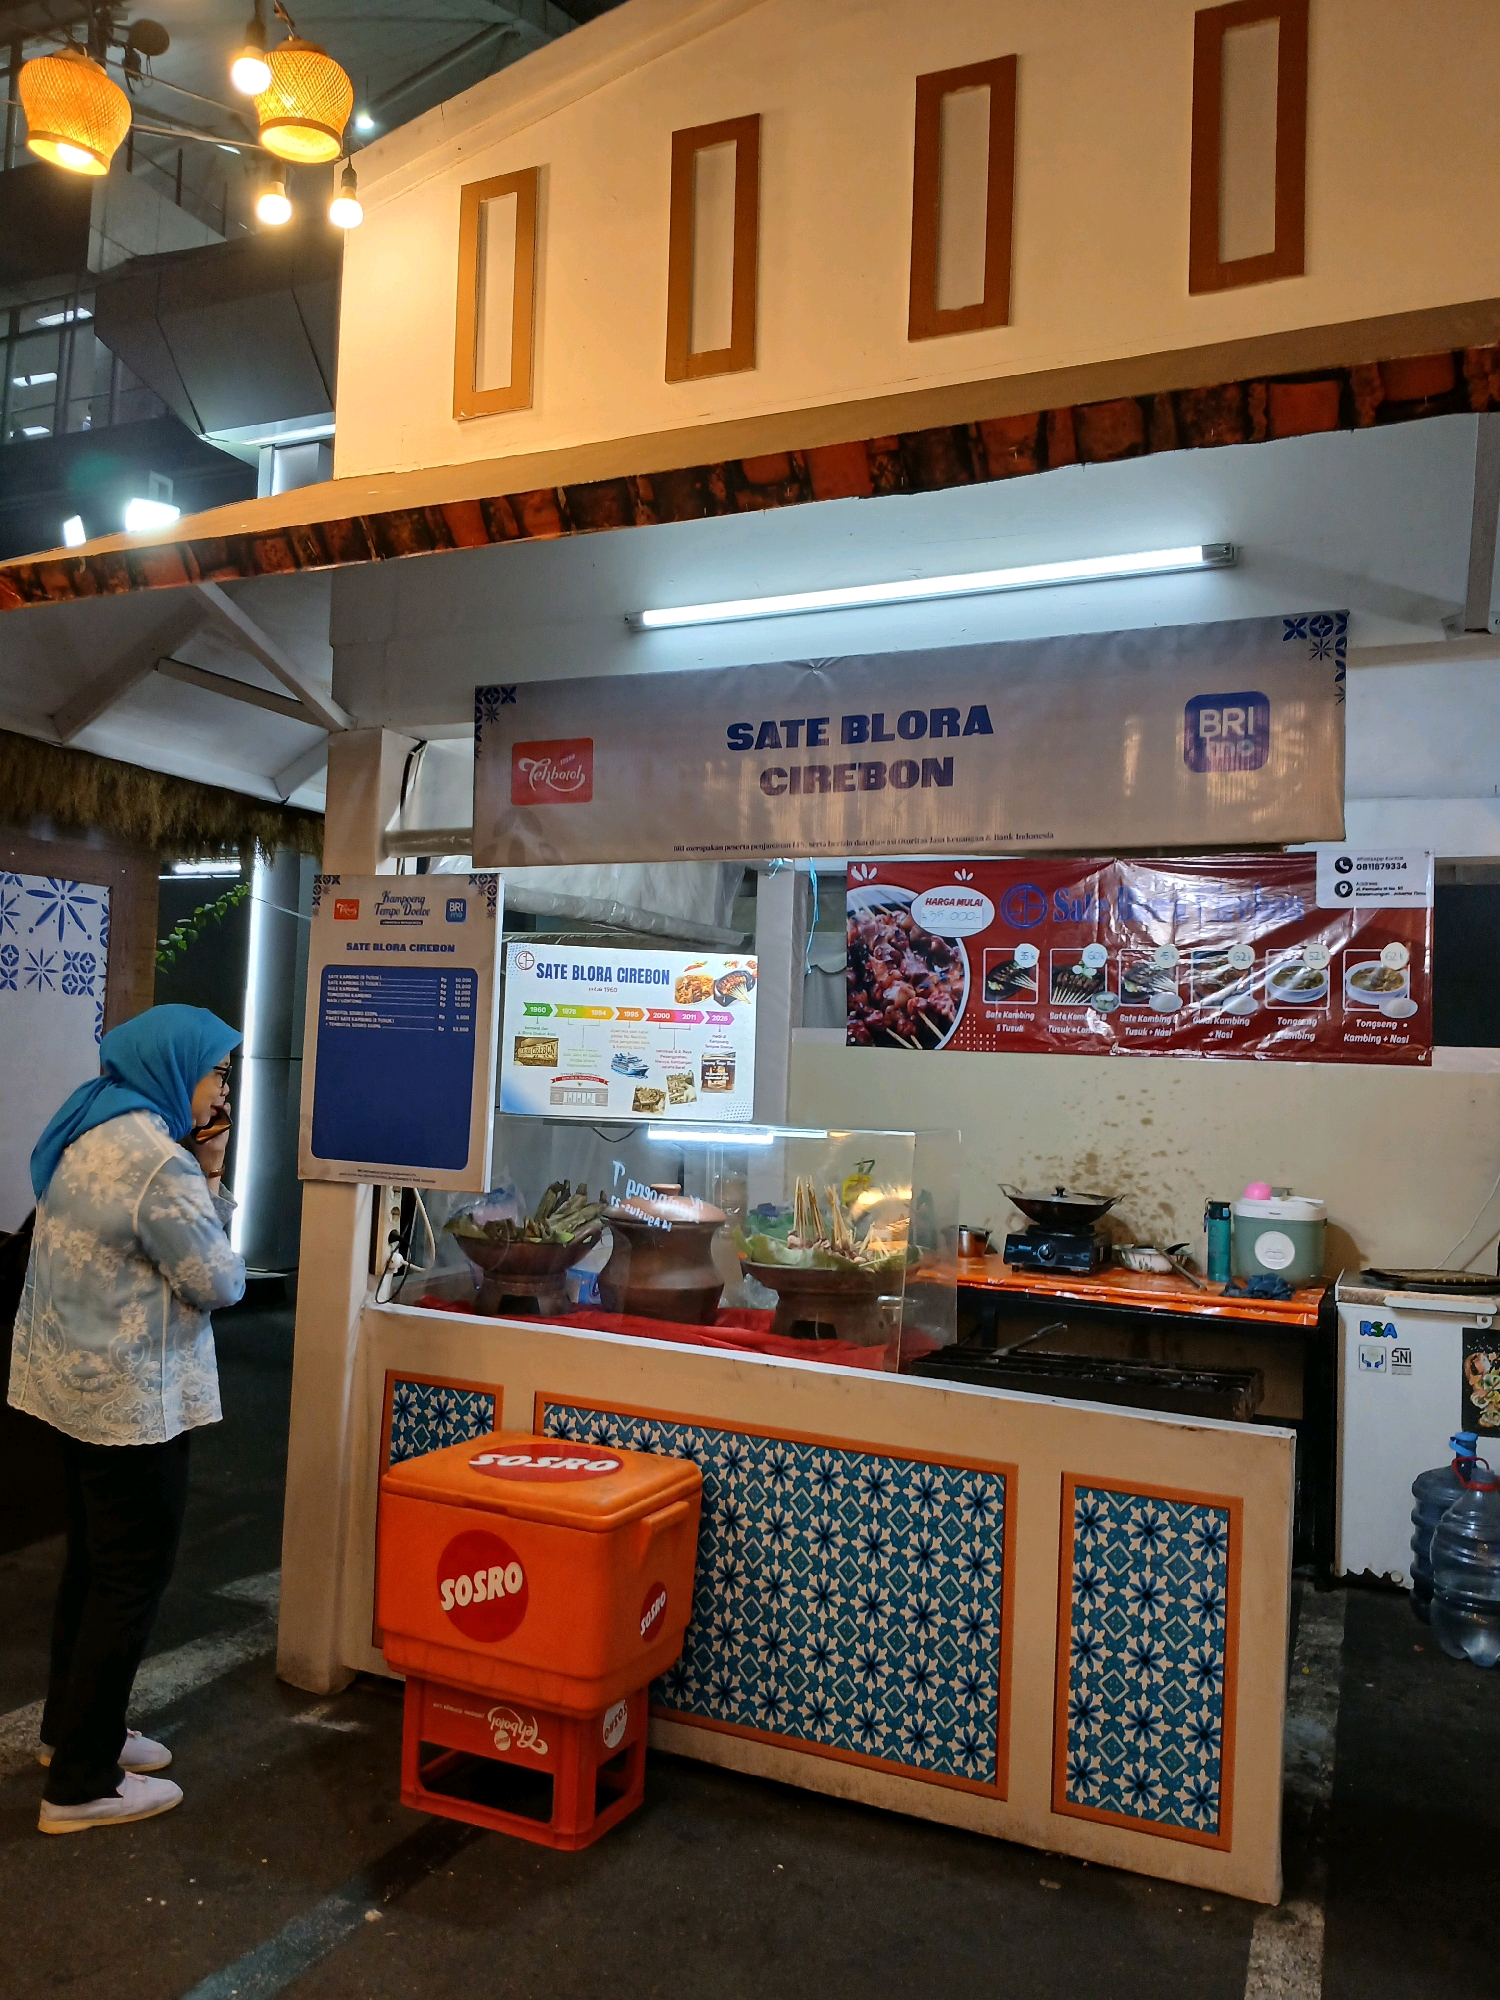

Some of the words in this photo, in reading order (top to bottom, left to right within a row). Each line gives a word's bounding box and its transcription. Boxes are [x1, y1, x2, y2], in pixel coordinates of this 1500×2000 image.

[1199, 706, 1255, 738] BRI
[727, 717, 830, 751] SATE
[840, 705, 994, 745] BLORA
[518, 757, 586, 792] Tehbotol
[759, 756, 954, 797] CIREBON
[1015, 831, 1055, 841] Indonesia
[382, 890, 426, 905] Kampoeng
[925, 897, 955, 906] HARGA
[956, 898, 983, 907] MULAI
[374, 903, 400, 918] Tempo
[449, 902, 464, 912] BRI
[346, 942, 371, 951] SATE
[372, 943, 407, 952] BLORA
[409, 944, 456, 953] CIREBON
[536, 962, 568, 980] SATE
[572, 965, 613, 983] BLORA
[617, 967, 670, 985] CIREBON
[623, 1010, 640, 1018] 1995
[653, 1012, 671, 1020] 2000
[682, 1013, 697, 1021] 2011
[985, 1011, 1003, 1020] Sate
[1004, 1011, 1035, 1021] Kambing
[1049, 1012, 1067, 1020] Sate
[1120, 1014, 1137, 1022] Sate
[1137, 1014, 1172, 1025] Kambing
[1213, 1016, 1250, 1026] Kambing
[1002, 1024, 1024, 1033] Tusuk
[1048, 1025, 1070, 1033] Tusuk
[1356, 1019, 1398, 1030] Tongseng
[1125, 1027, 1147, 1036] Tusuk
[1154, 1028, 1172, 1036] Nasi
[1215, 1030, 1234, 1039] Nasi
[1343, 1033, 1382, 1045] Kambing
[1390, 1034, 1410, 1044] Nasi
[1359, 1320, 1398, 1338] RSA
[1391, 1347, 1412, 1364] SNI
[469, 1453, 620, 1472] SOSRO
[440, 1561, 523, 1612] SOSRO
[640, 1591, 667, 1636] SOSRO
[487, 1706, 548, 1755] Tehbotol
